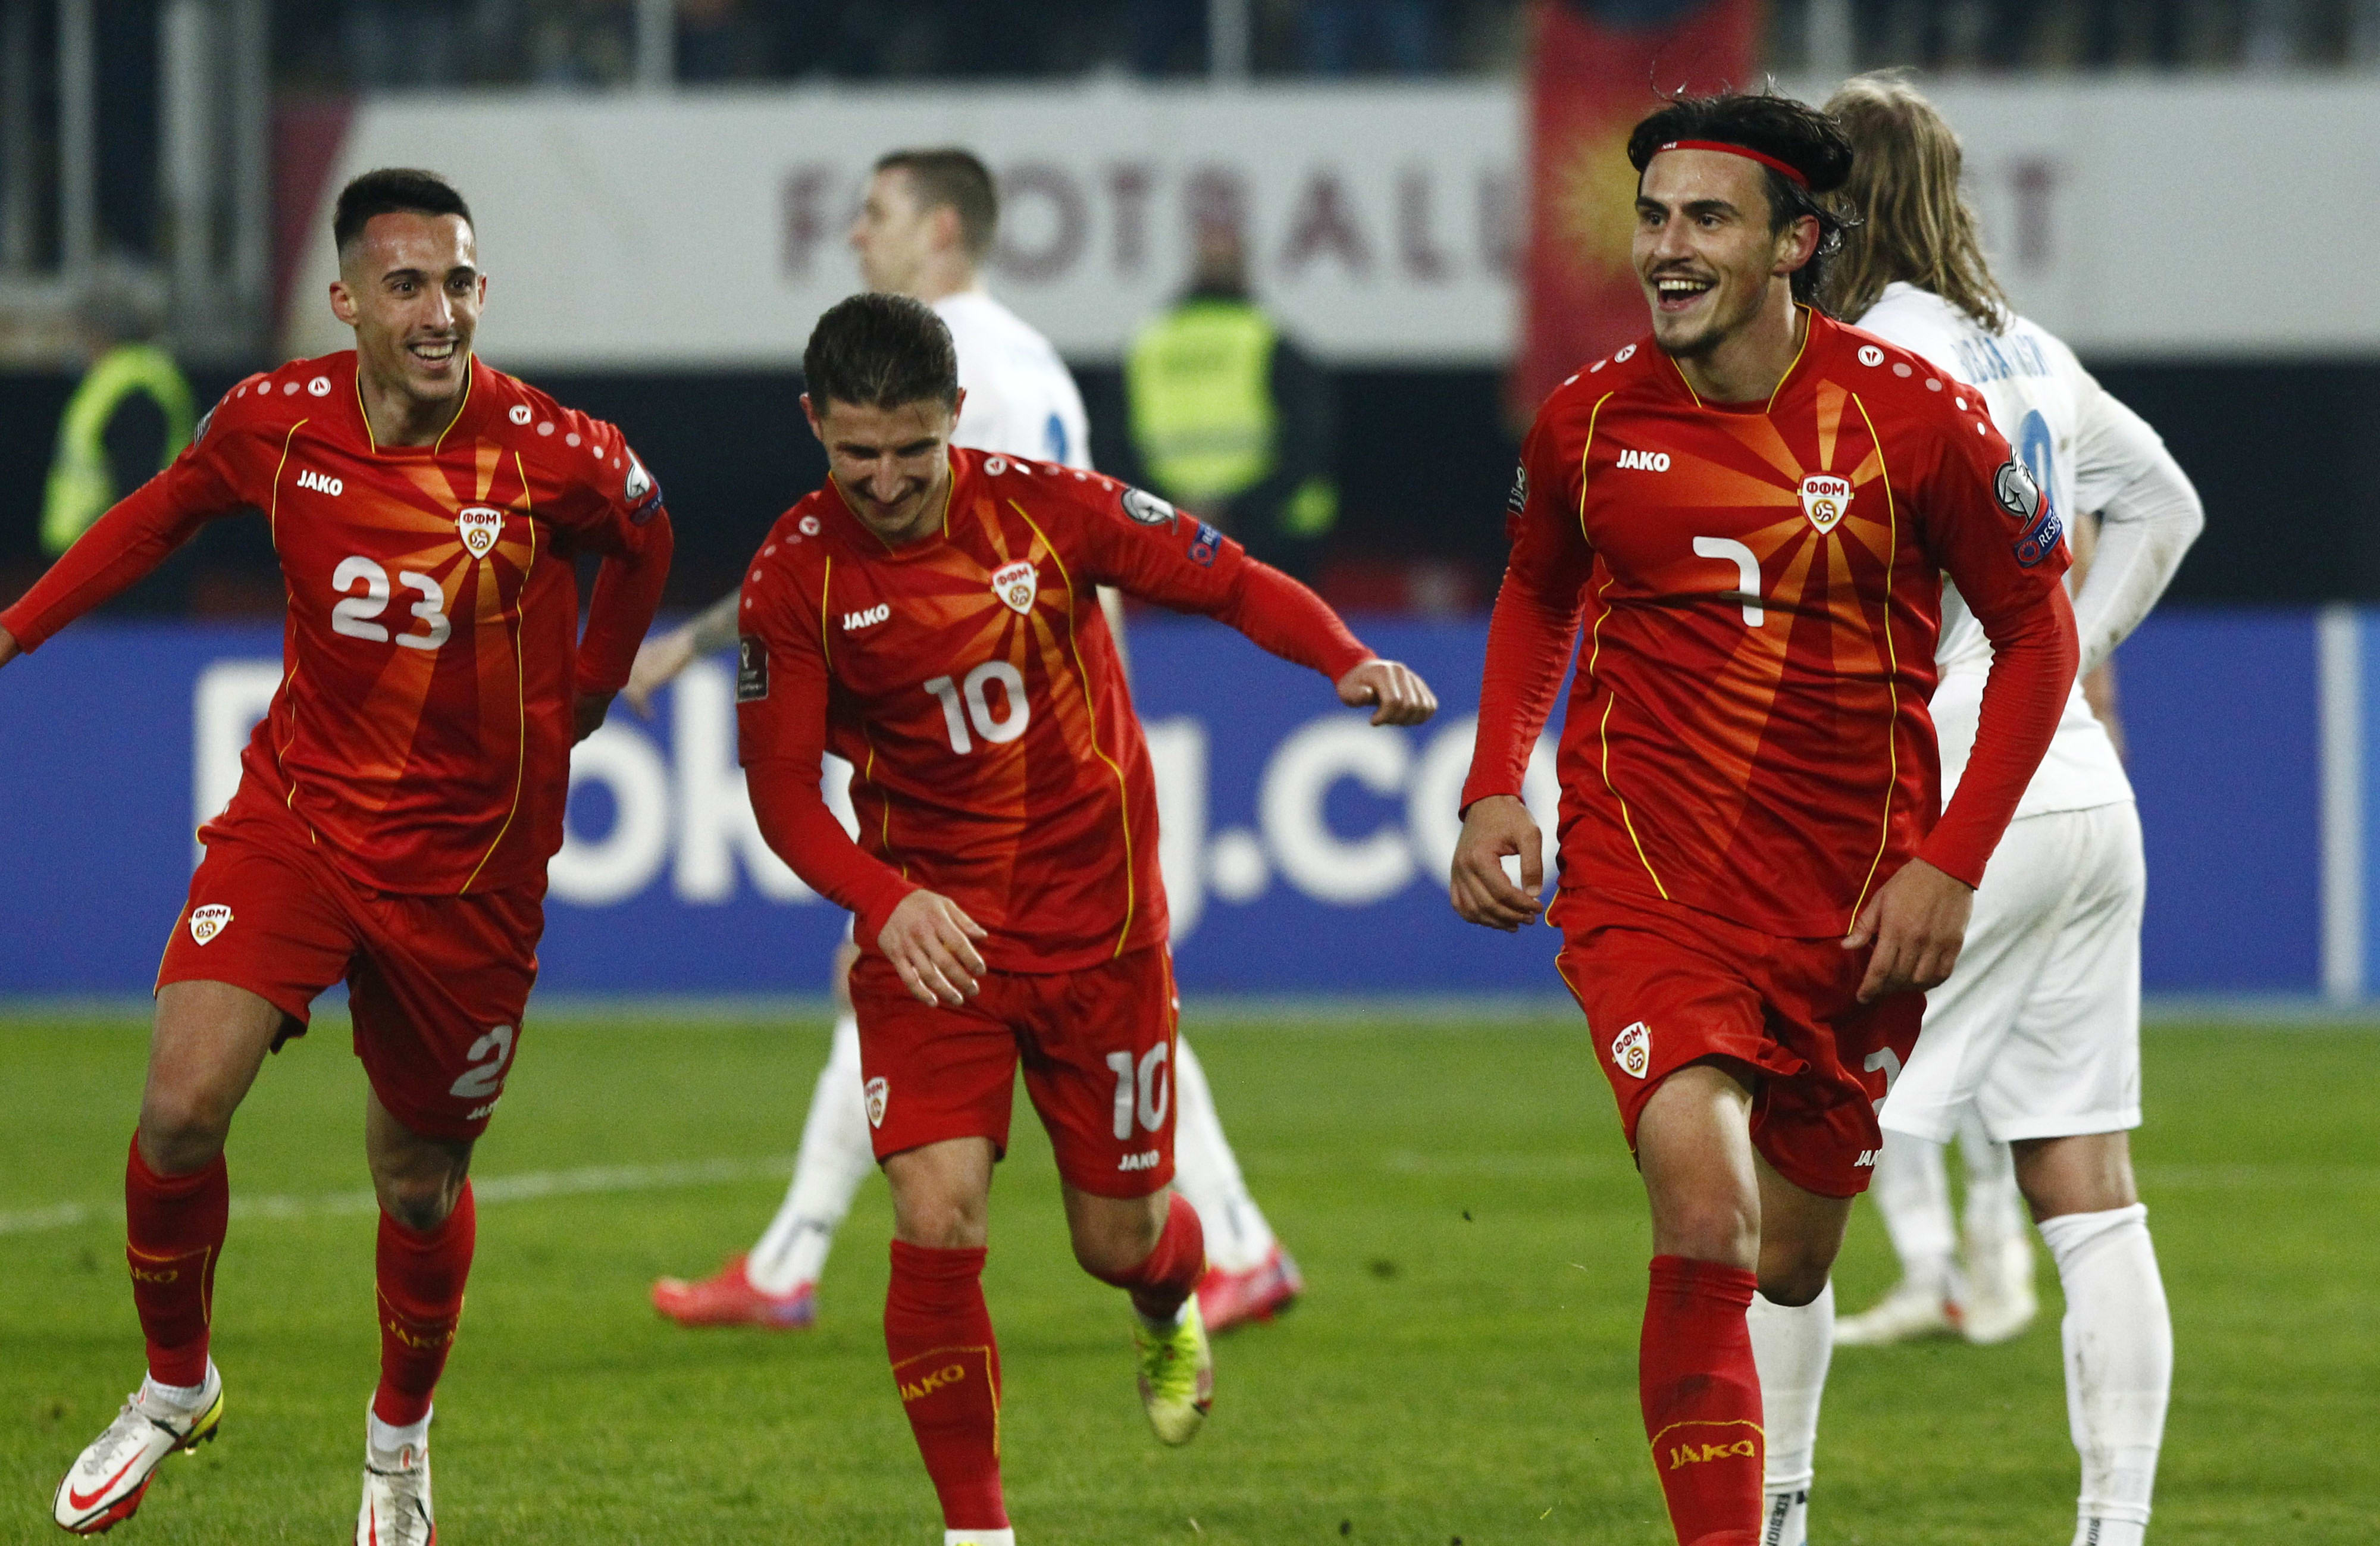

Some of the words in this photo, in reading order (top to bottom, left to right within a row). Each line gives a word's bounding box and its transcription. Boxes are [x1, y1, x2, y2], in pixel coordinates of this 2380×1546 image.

[1616, 449, 1671, 472] JAKO
[297, 470, 343, 496] JAKO
[1806, 481, 1844, 496] ФФМ
[463, 513, 497, 525] ФФМ
[997, 567, 1029, 586] ФФМ
[1692, 536, 1764, 628] 7
[332, 555, 452, 650] 23
[843, 603, 890, 631] JAKO
[923, 661, 1031, 755] 10
[196, 908, 227, 918] ФФМ
[1615, 1025, 1642, 1054] ФФМ
[1106, 1041, 1168, 1141] 10
[1117, 1149, 1160, 1171] JAKO
[1853, 1149, 1882, 1167] JAK
[1670, 1440, 1755, 1470] JAKO
